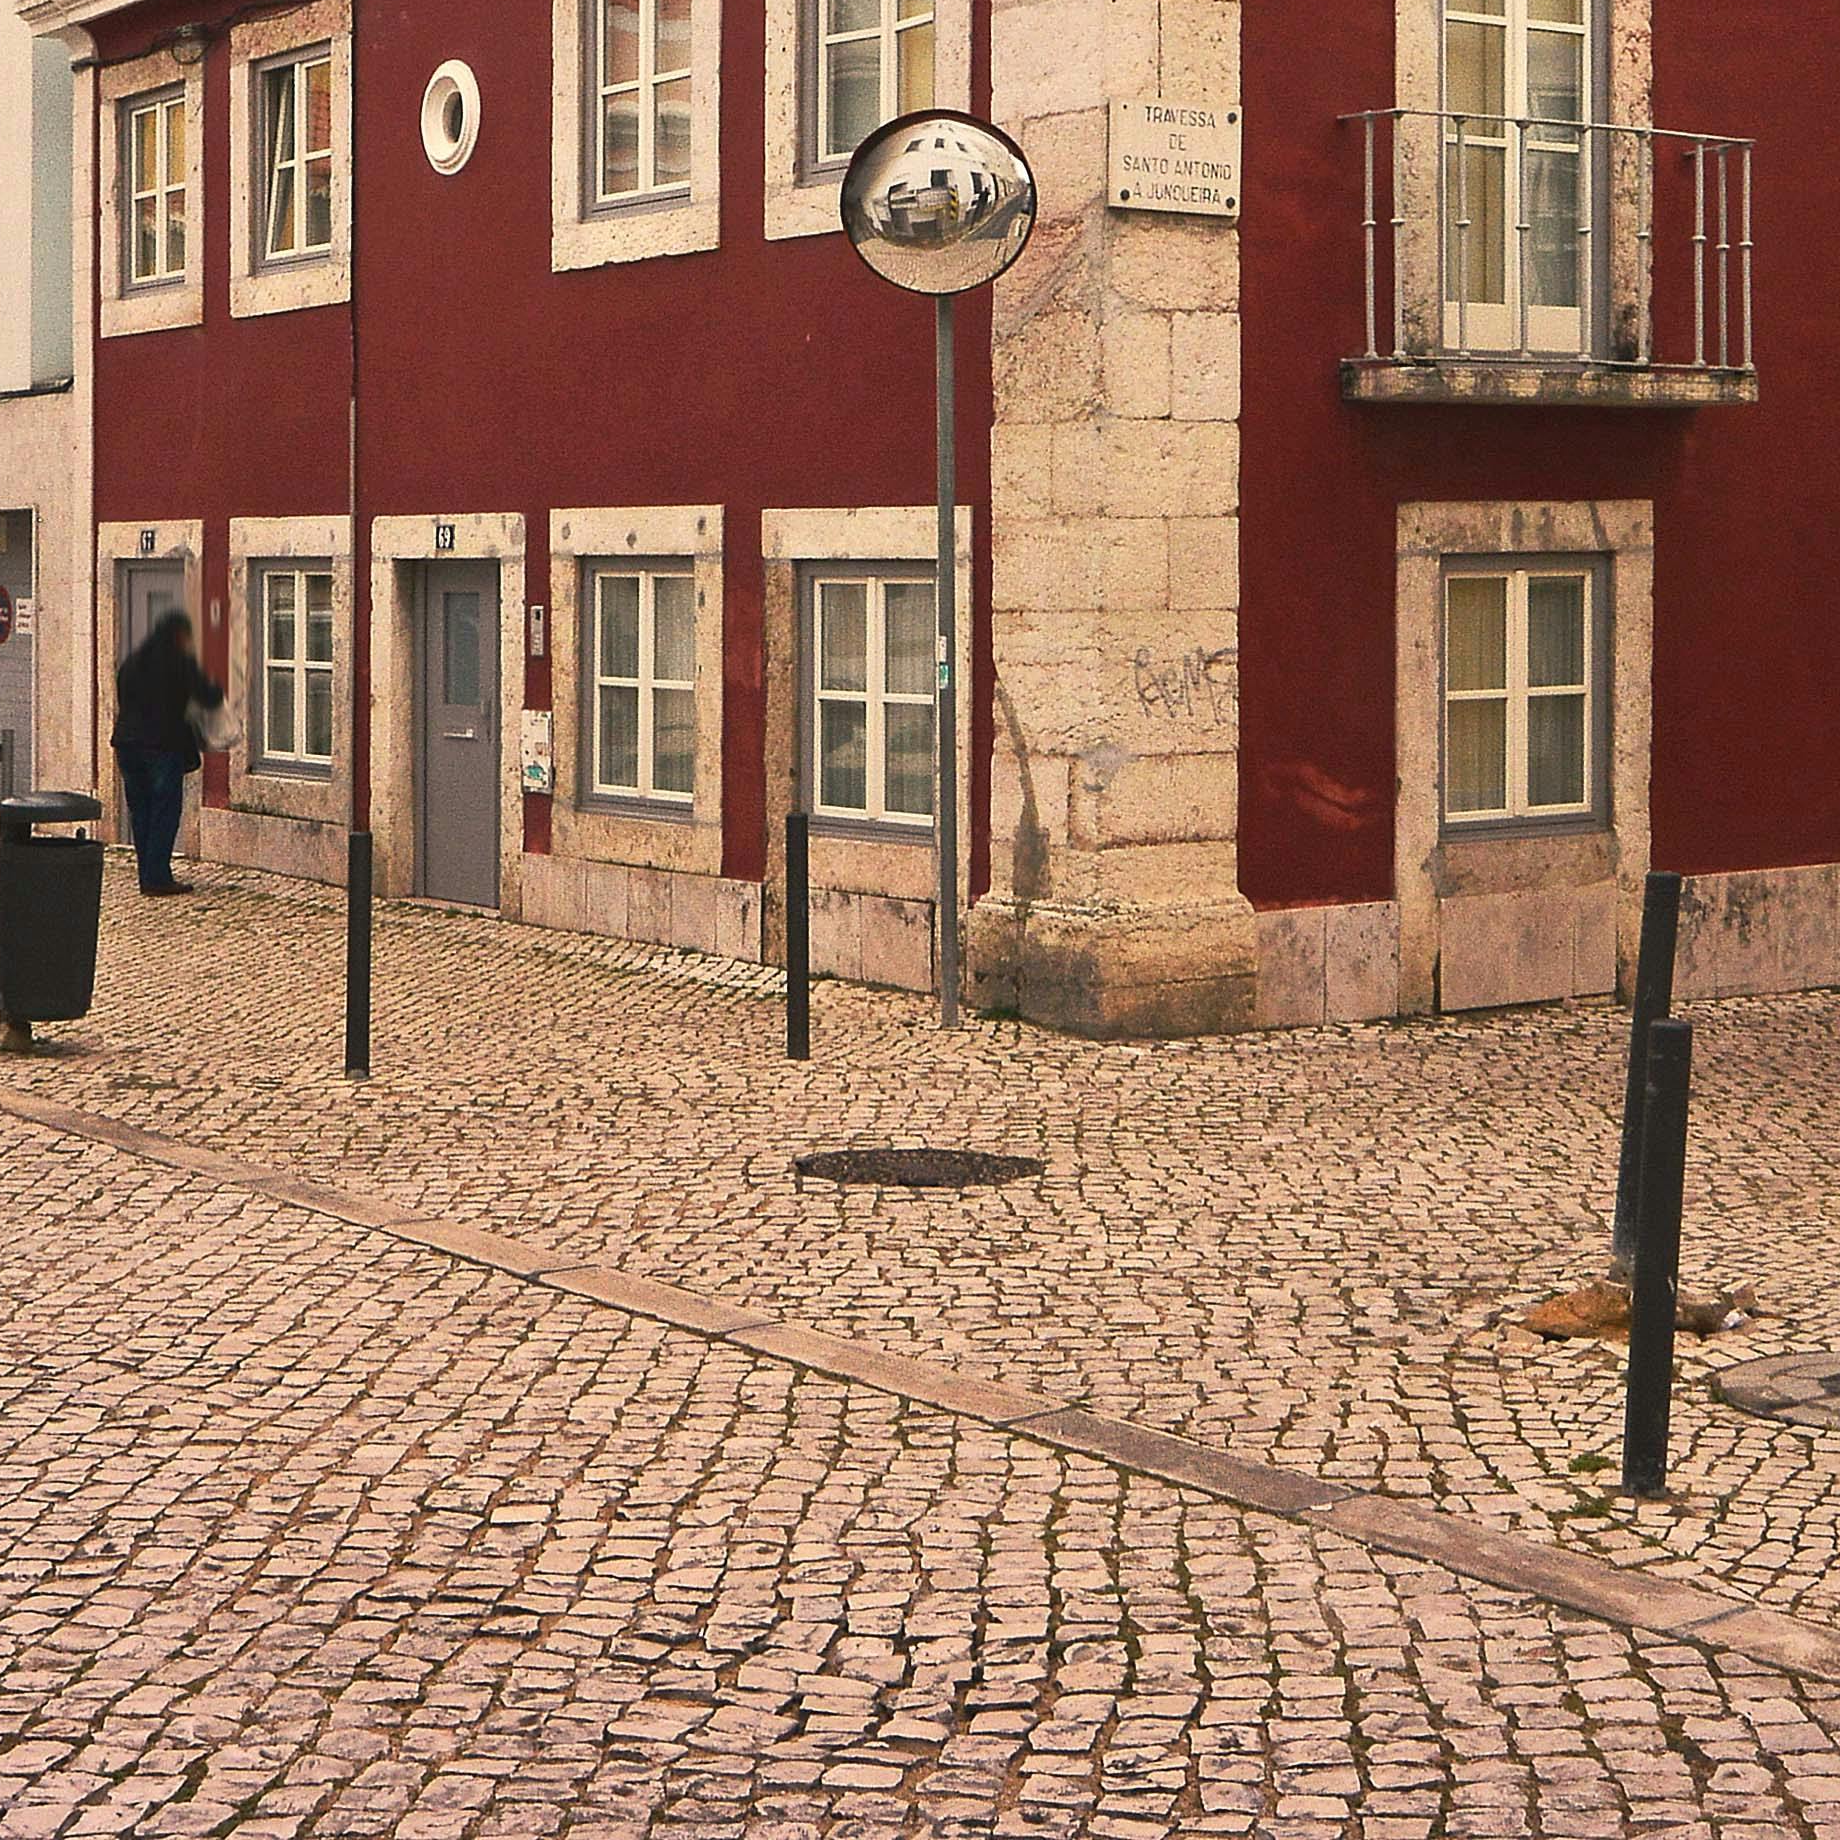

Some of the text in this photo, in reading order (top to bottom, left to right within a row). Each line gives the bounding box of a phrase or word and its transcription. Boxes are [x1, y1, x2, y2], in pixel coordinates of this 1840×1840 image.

[1145, 106, 1216, 128] TRAVESSA
[1169, 134, 1187, 151] DE
[1123, 155, 1232, 180] SANTO ANTONIO
[439, 527, 450, 548] 69
